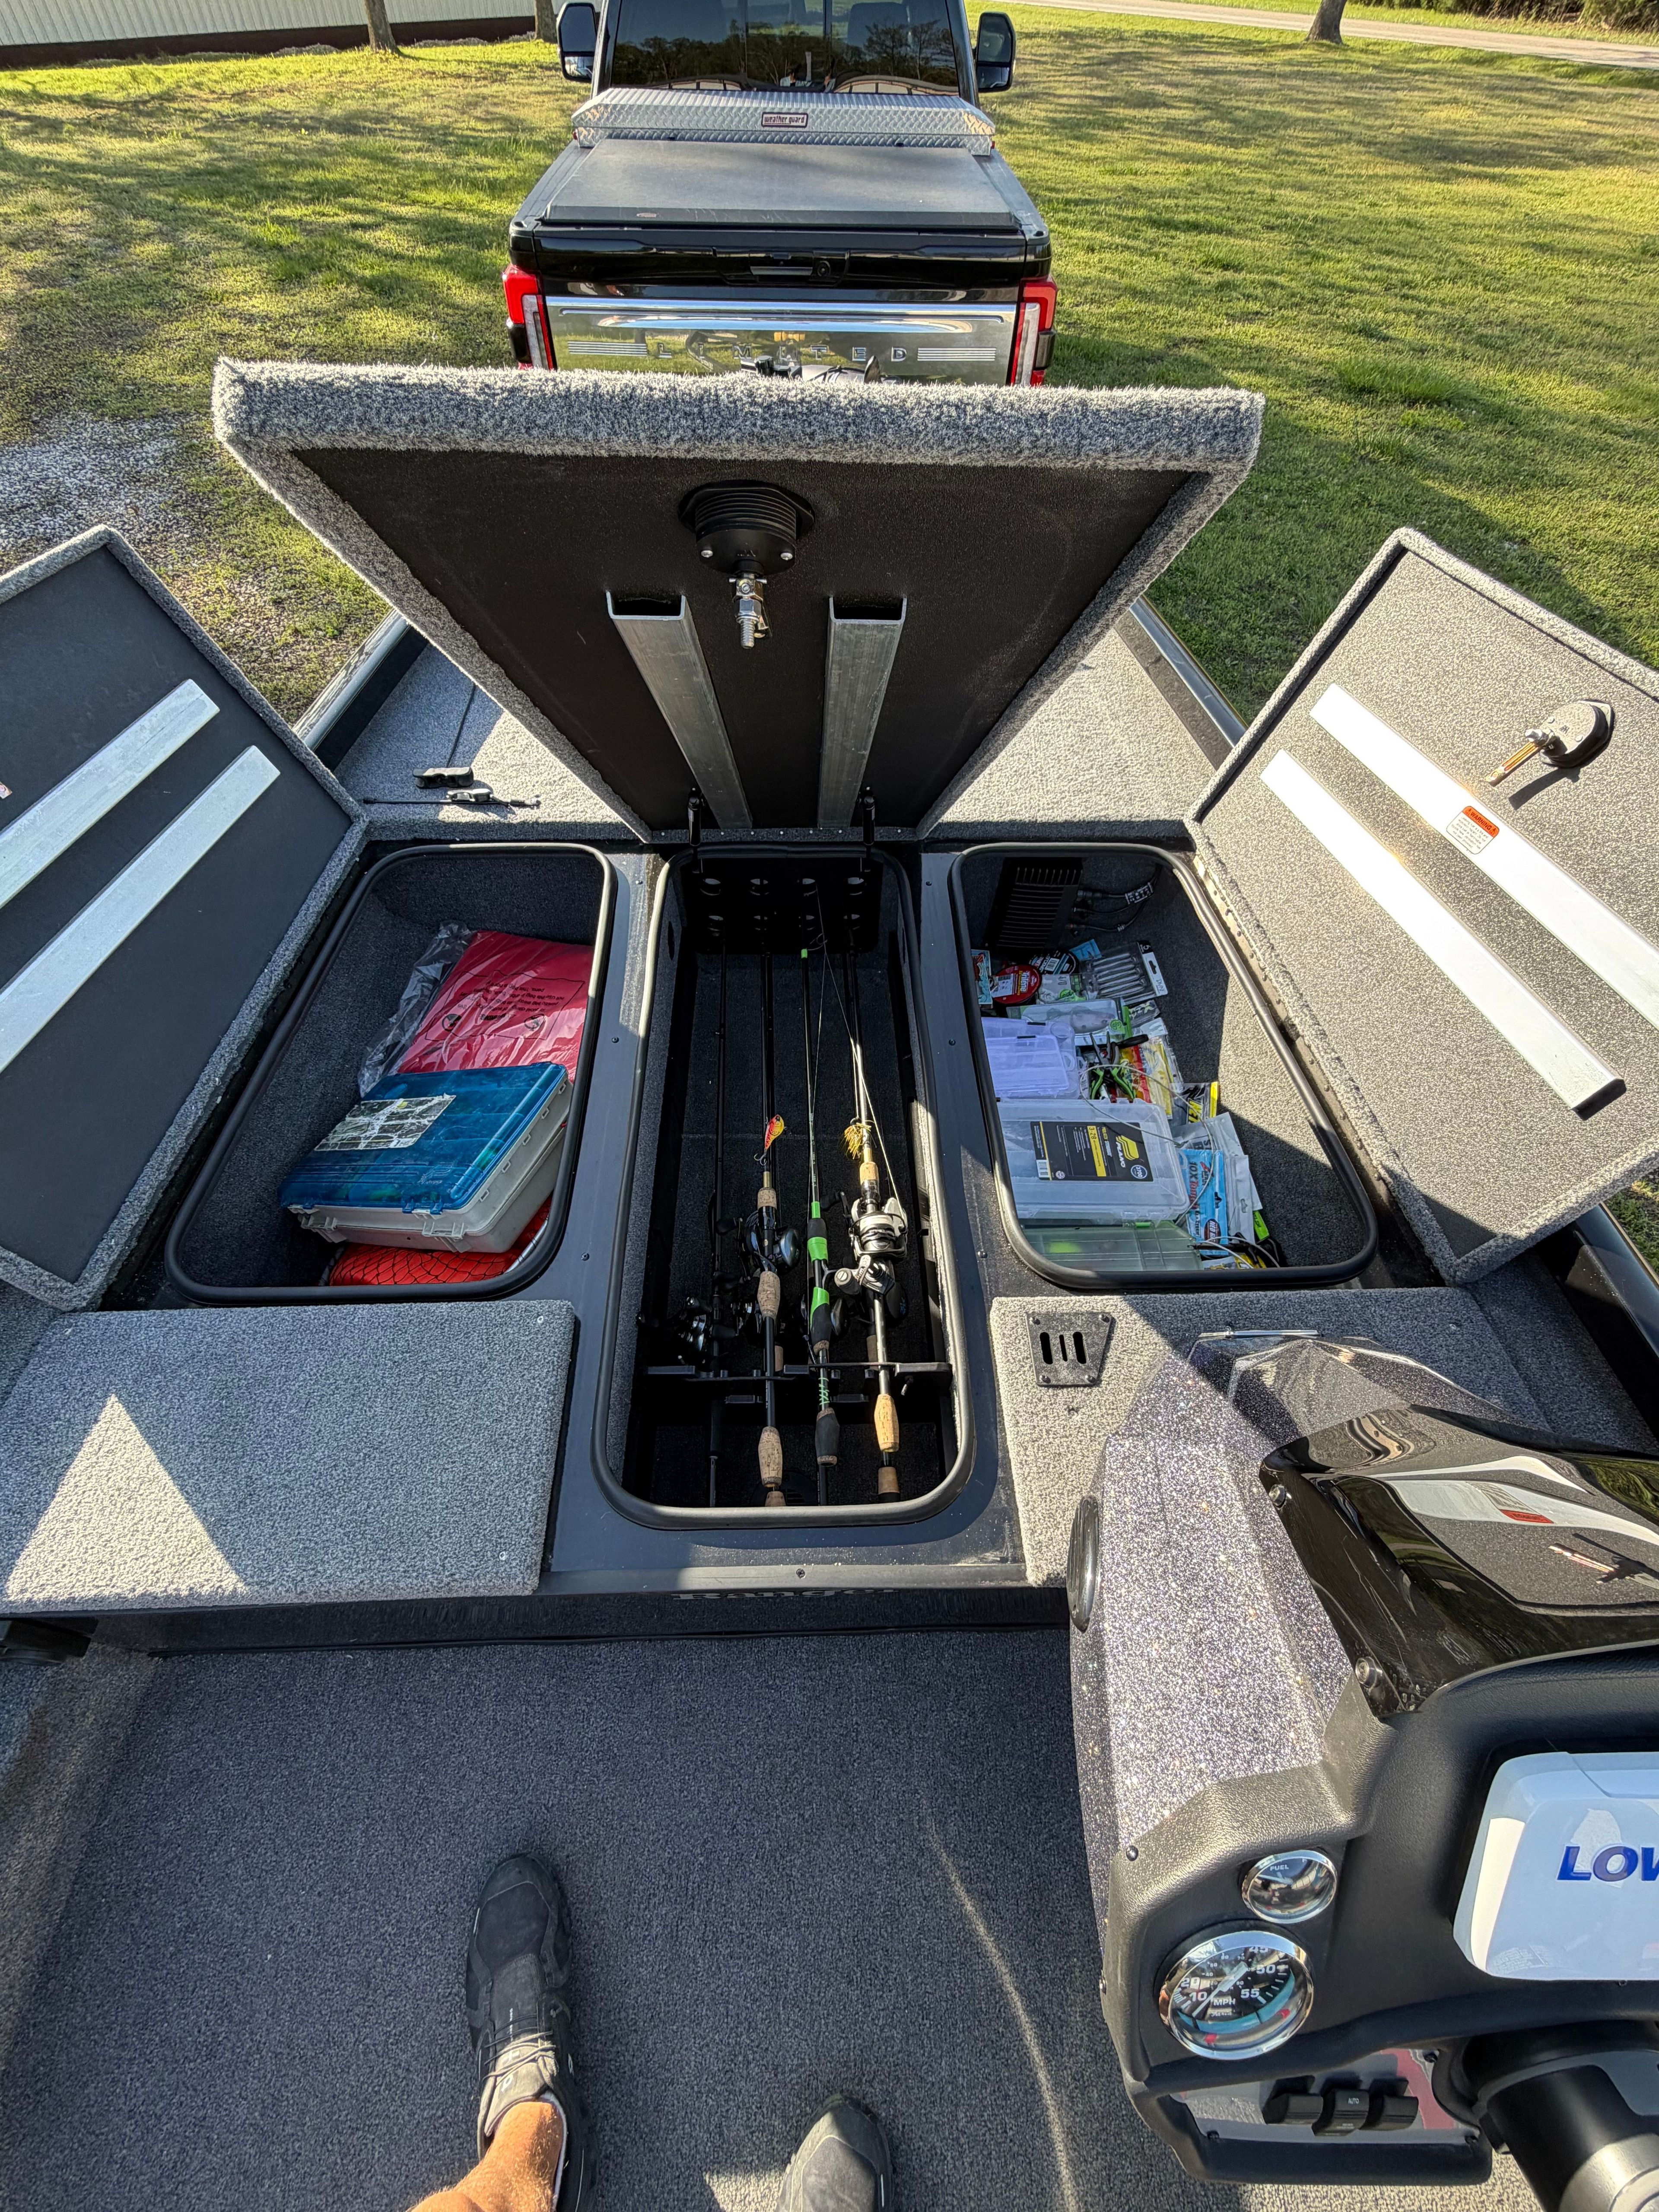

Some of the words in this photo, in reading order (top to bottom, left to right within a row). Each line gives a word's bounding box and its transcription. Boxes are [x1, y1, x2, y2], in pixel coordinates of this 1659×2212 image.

[788, 116, 805, 124] guard
[657, 343, 907, 362] LIMITED
[1470, 811, 1492, 831] WARNING
[1089, 1127, 1097, 1139] 3-28
[1116, 1142, 1126, 1168] PLANO
[1181, 1977, 1200, 1988] 20
[1189, 1991, 1207, 2002] 10
[1240, 1989, 1260, 1999] 55
